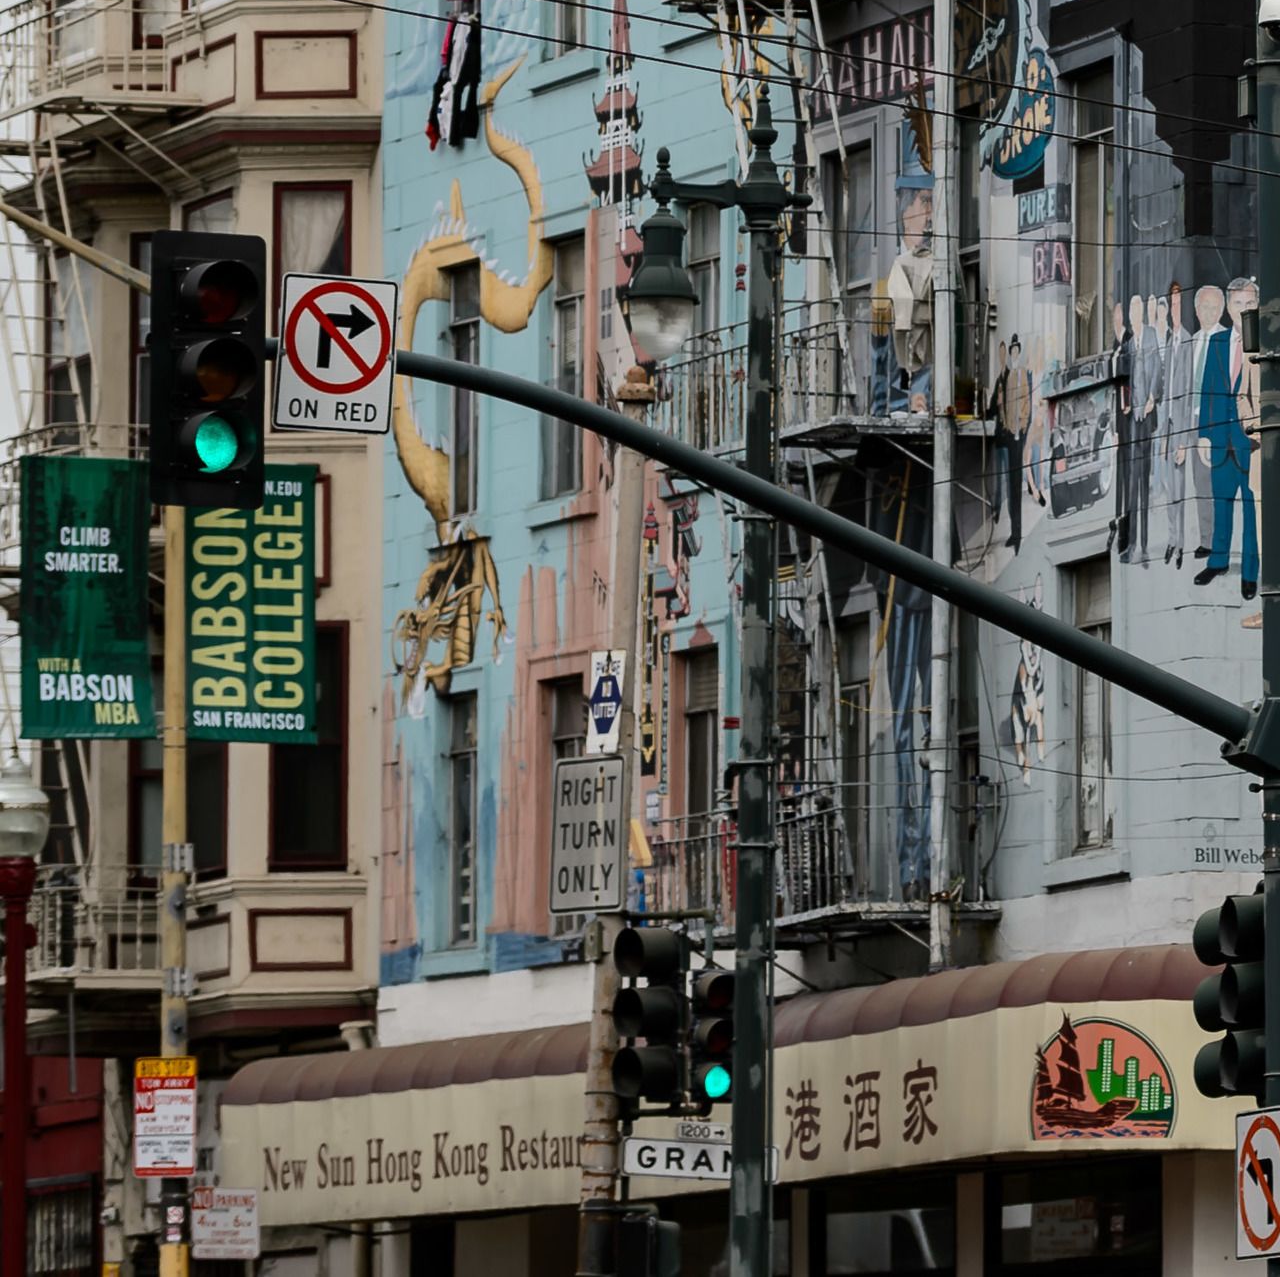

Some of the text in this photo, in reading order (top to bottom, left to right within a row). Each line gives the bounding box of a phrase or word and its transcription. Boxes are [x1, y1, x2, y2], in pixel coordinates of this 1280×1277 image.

[288, 397, 378, 423] ON RED
[265, 480, 302, 496] N.EDU
[60, 526, 111, 547] CLIMB
[45, 552, 124, 573] SMARTER.
[191, 508, 248, 707] BABSON
[253, 501, 305, 709] COLLEGE
[38, 658, 82, 672] WITH A
[39, 674, 135, 703] BABSON
[94, 703, 140, 725] MBA
[193, 710, 305, 731] SAN FRANCISCO
[560, 775, 617, 807] RIGHT
[560, 819, 616, 851] TURN
[1194, 847, 1265, 865] Bill Webe
[557, 863, 614, 894] ONLY
[141, 1062, 191, 1075] BUS STOP
[135, 1092, 154, 1110] NO
[681, 1124, 711, 1138] 1200
[263, 1146, 308, 1192] New
[317, 1142, 355, 1189] Sun
[366, 1138, 422, 1192] Hong
[432, 1131, 489, 1186] Kong
[499, 1124, 584, 1172] Restaur
